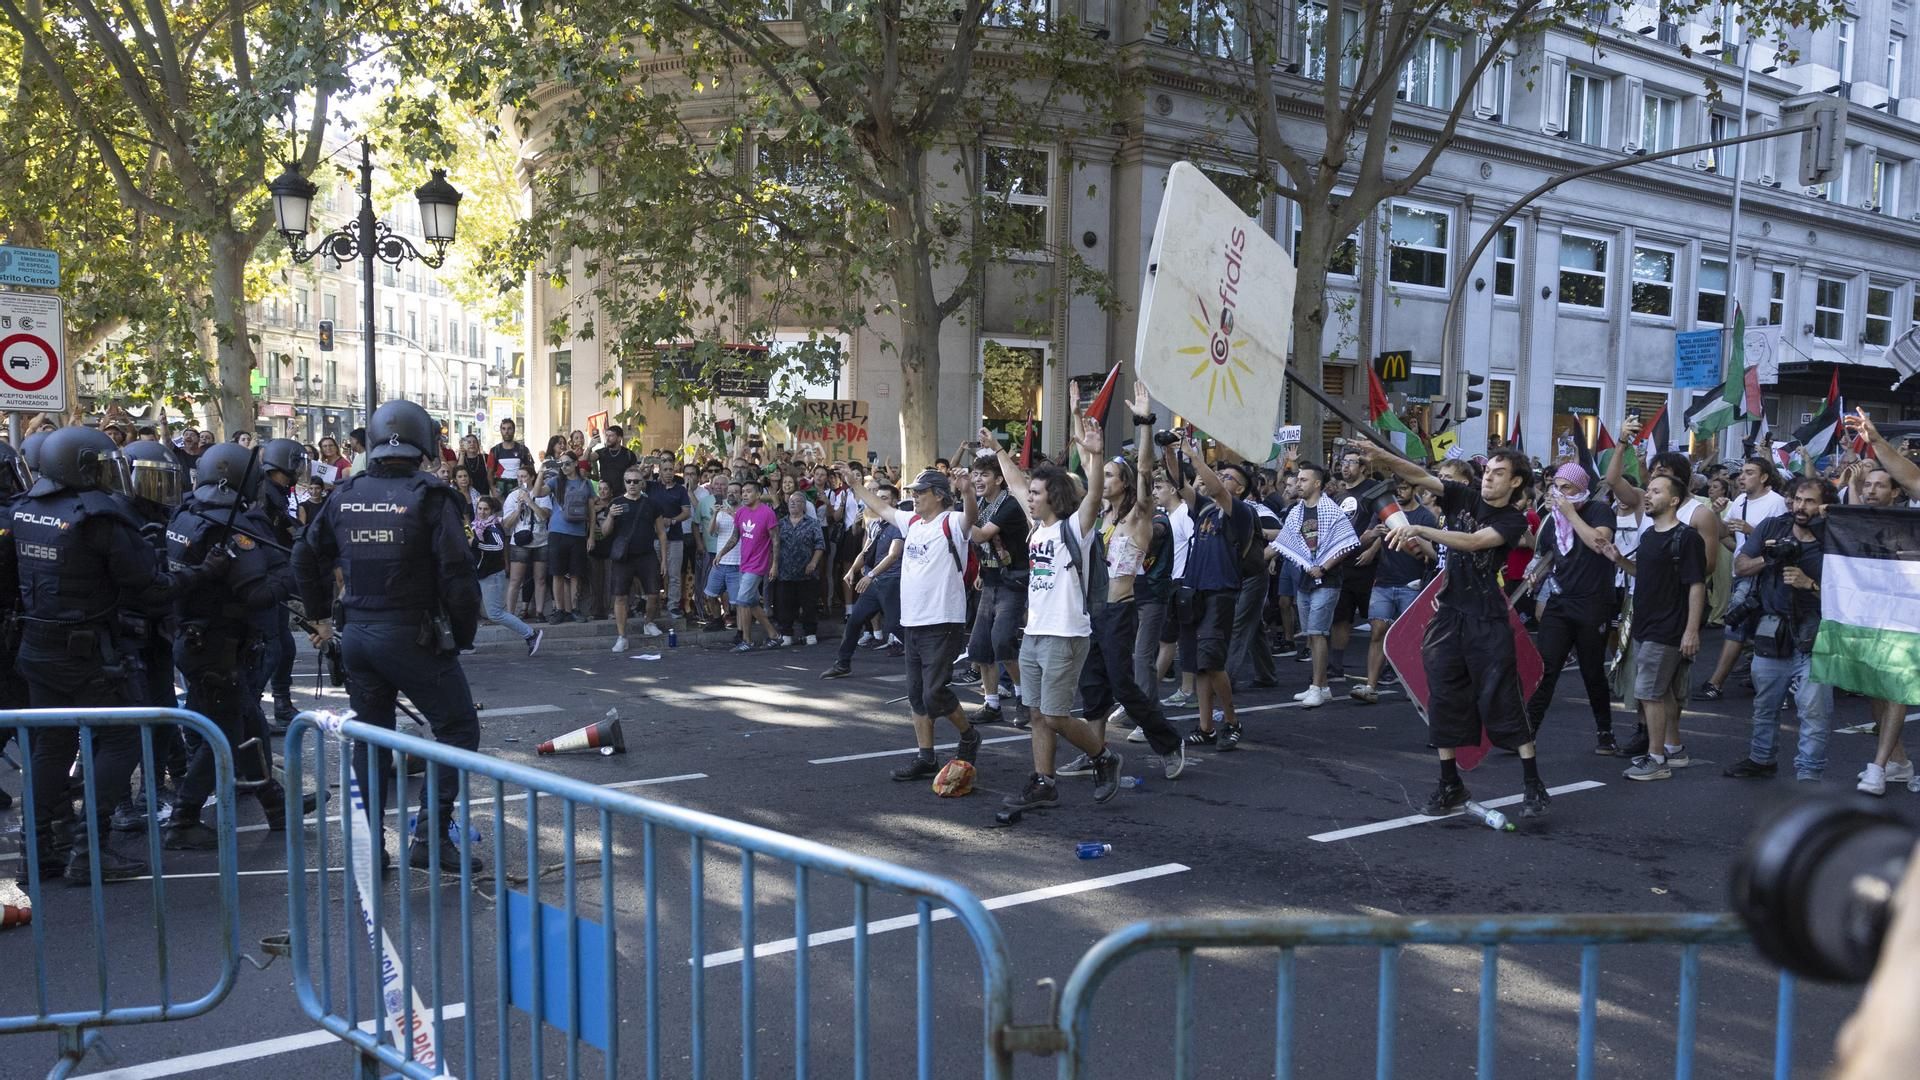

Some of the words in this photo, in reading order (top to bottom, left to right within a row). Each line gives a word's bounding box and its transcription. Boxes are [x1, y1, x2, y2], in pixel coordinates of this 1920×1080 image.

[24, 275, 56, 285] Centro
[1286, 429, 1300, 439] WAR
[350, 529, 394, 543] UC431
